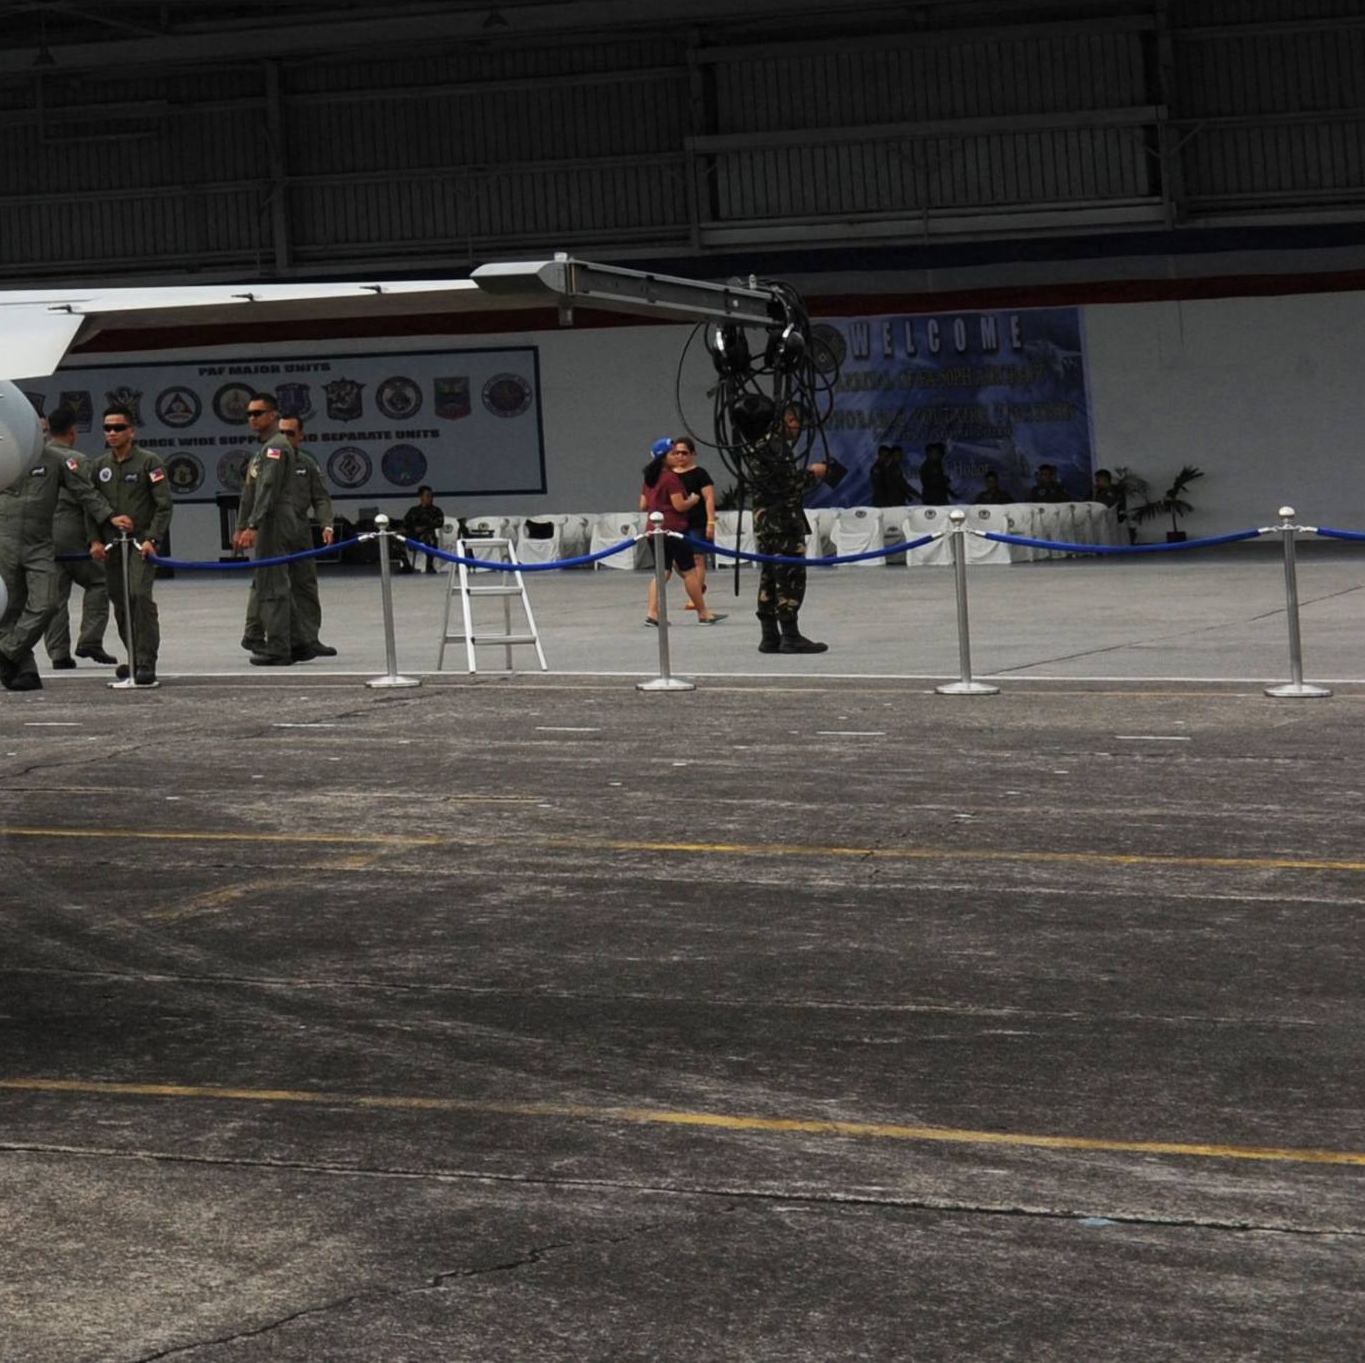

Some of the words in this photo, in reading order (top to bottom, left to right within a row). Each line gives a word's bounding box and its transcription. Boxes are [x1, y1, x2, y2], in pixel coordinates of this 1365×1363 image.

[851, 315, 1023, 357] WELCOME
[198, 366, 225, 376] PAF
[229, 365, 280, 375] MAJOR
[284, 363, 331, 373] UNITS
[178, 436, 216, 447] WIDE
[321, 430, 392, 442] SEPARATE
[395, 429, 440, 440] UNITS
